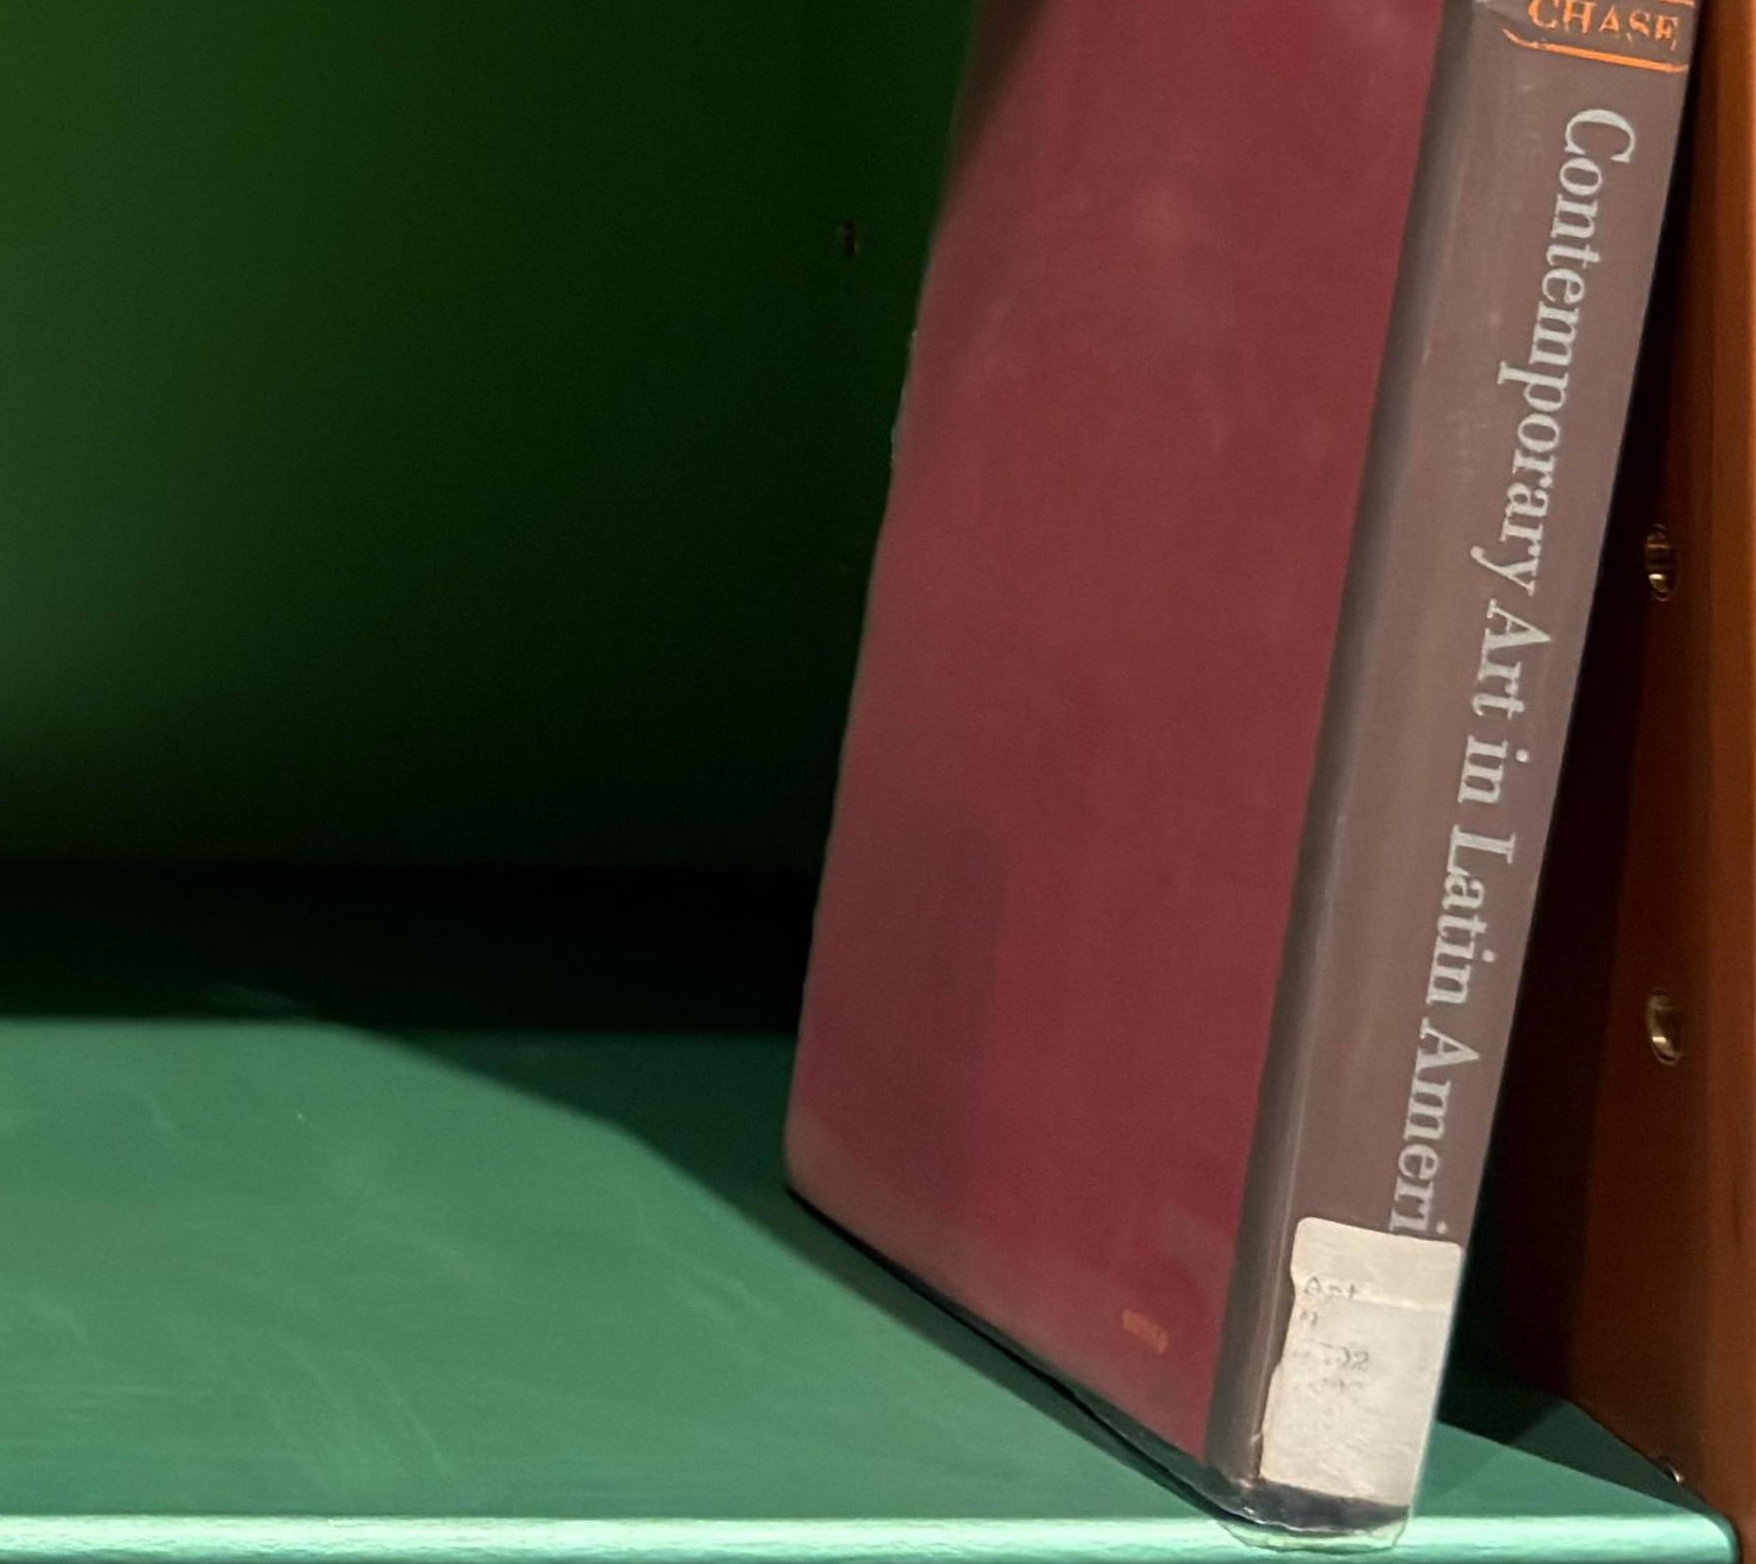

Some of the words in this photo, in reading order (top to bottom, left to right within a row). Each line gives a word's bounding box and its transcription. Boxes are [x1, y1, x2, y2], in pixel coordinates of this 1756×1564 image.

[1470, 107, 1636, 596] Contemporary
[1470, 597, 1551, 722] Art
[1457, 734, 1530, 805] in
[1425, 824, 1517, 1006] Latin
[1390, 1016, 1480, 1237] Ameri
